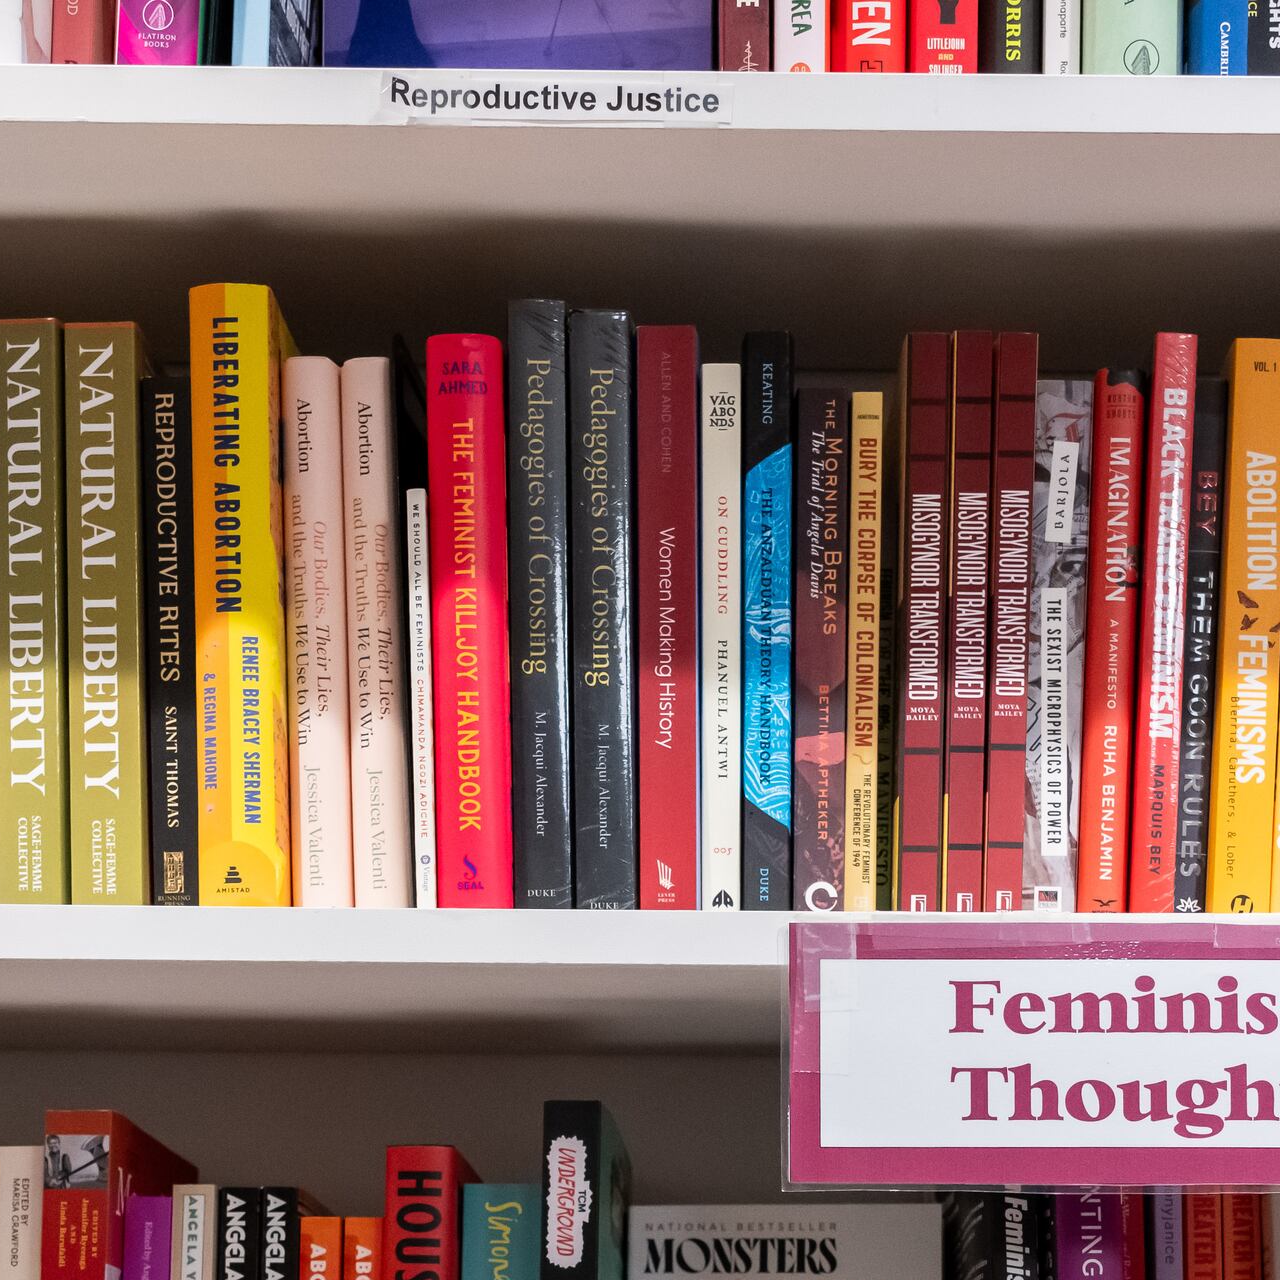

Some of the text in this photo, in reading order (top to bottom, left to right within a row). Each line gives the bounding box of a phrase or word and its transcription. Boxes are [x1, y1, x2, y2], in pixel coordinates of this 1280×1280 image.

[390, 76, 720, 114] Reproductive Justice
[927, 37, 966, 50] LITTLEJOHN
[6, 338, 46, 797] NATURAL LIBERTY
[211, 316, 242, 614] LIBERATING ABORTION
[452, 417, 481, 831] THE FEMINIST KILLJOY HANDBOOK
[1046, 598, 1063, 846] THE SEXIST MICROPHYSICS OF POWER
[643, 1237, 839, 1275] MONSTERS
